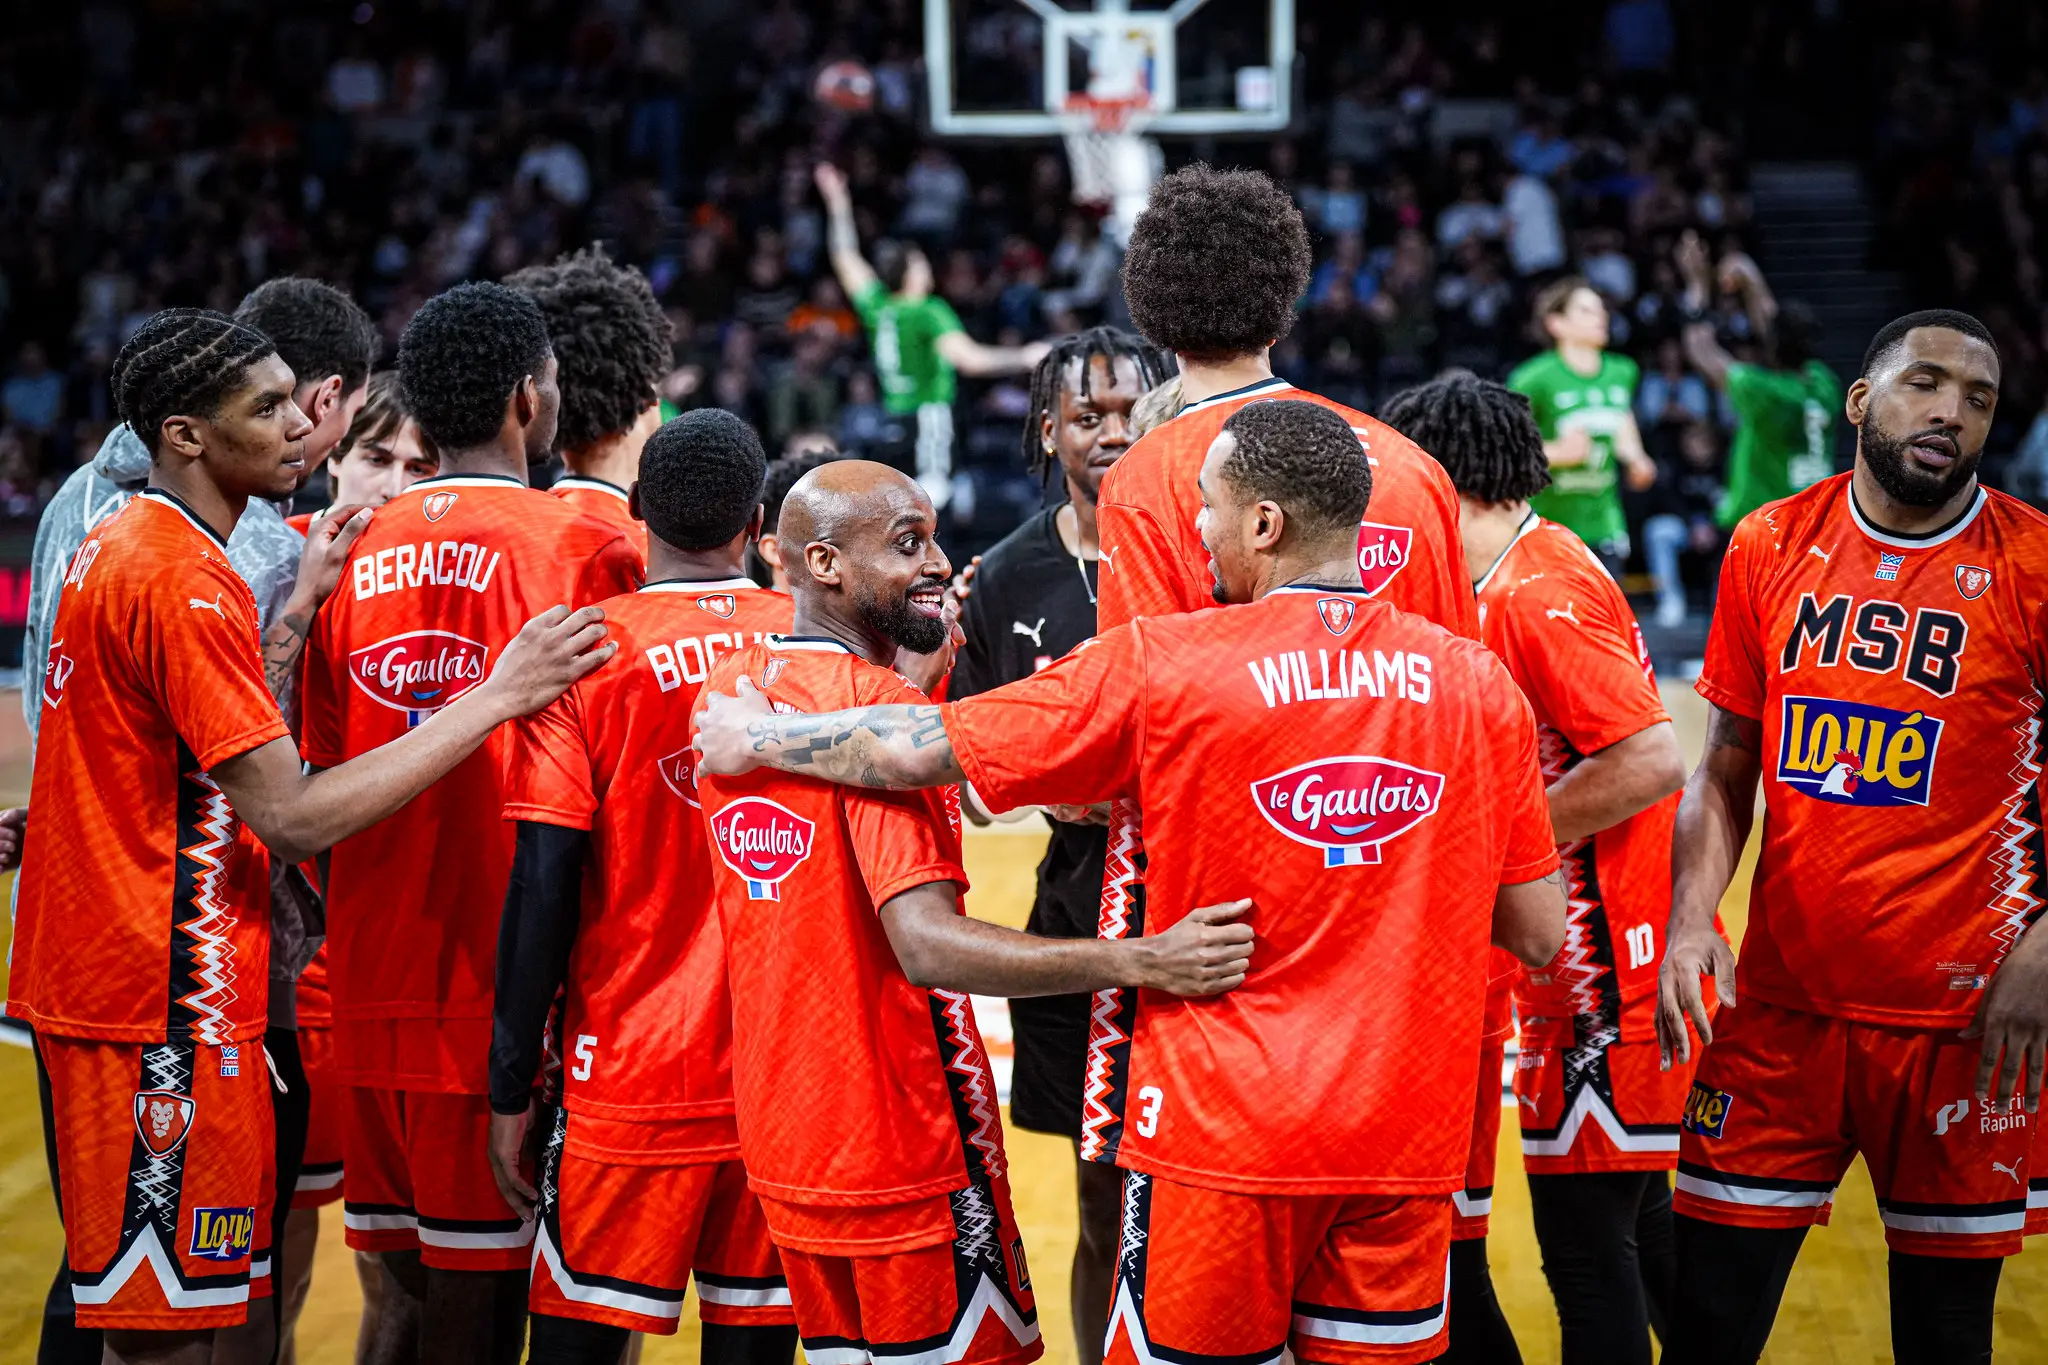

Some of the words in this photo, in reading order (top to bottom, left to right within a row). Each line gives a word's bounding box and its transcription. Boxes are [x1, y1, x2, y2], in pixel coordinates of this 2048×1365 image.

[353, 541, 501, 601] BERACOU
[361, 655, 378, 678] le
[379, 647, 481, 695] Gaulois
[1780, 591, 1969, 699] MSB
[1248, 648, 1432, 708] WILLIAMS
[674, 759, 689, 781] le
[1785, 704, 1926, 789] Loué
[1270, 784, 1290, 809] le
[1291, 774, 1431, 830] Gaulois
[719, 819, 729, 841] le
[729, 811, 805, 863] Gaulois
[1625, 922, 1654, 969] 10
[572, 1034, 598, 1081] 5
[1136, 1086, 1164, 1138] 3
[1981, 1112, 2026, 1134] Rapin
[197, 1207, 251, 1248] Loué
